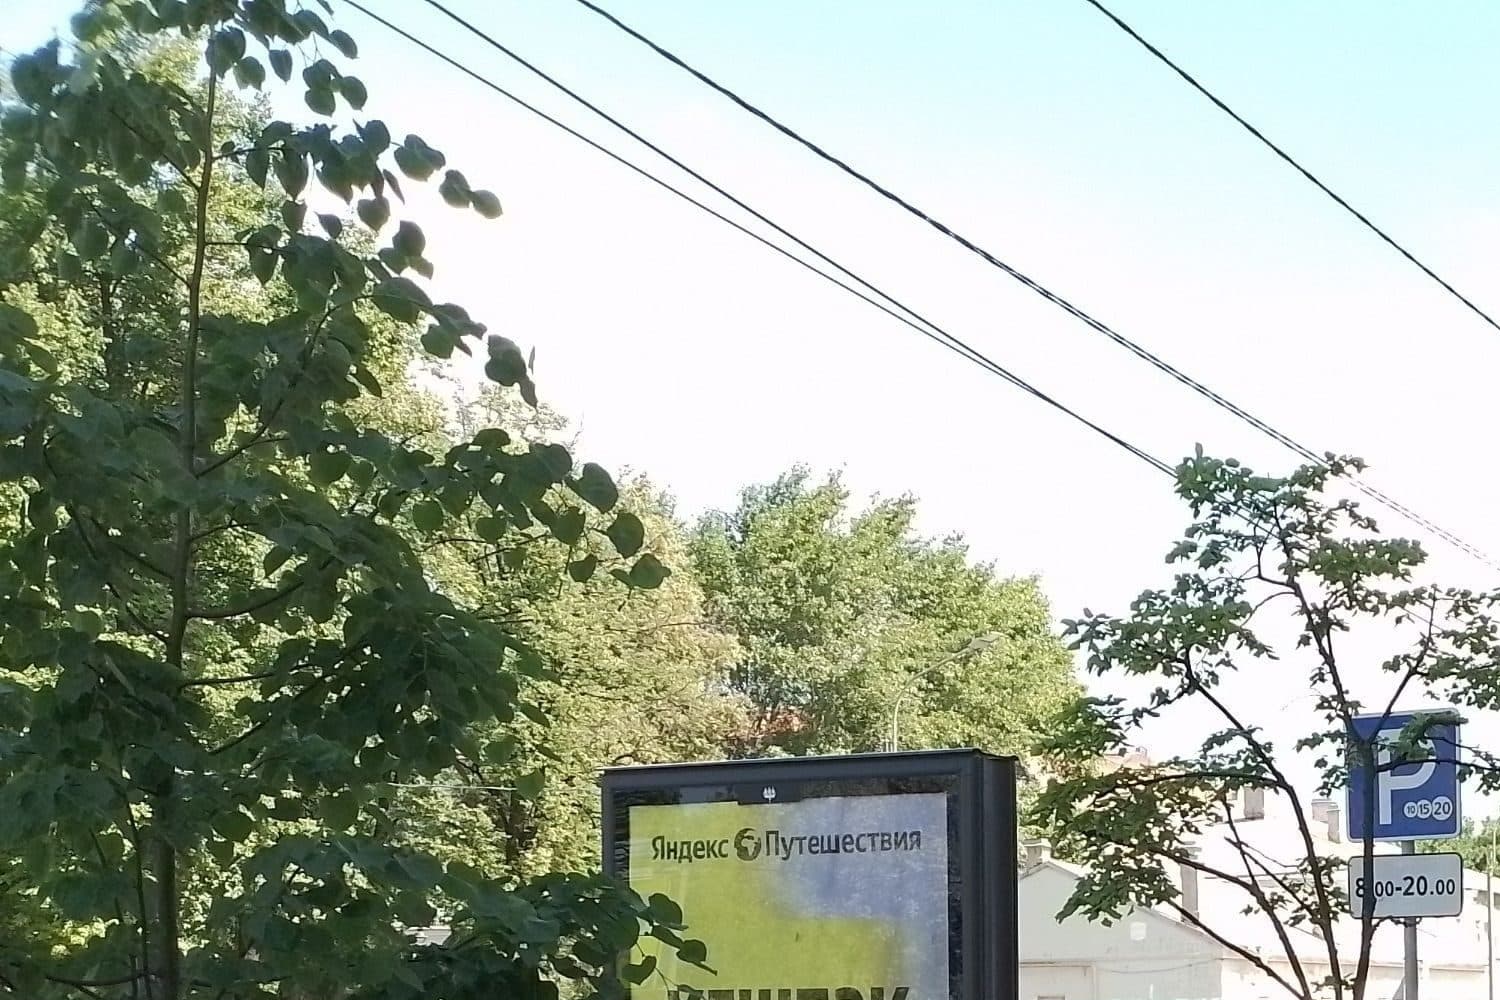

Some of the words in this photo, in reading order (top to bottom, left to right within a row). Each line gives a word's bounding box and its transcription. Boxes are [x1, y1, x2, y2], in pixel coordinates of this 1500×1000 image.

[652, 835, 729, 863] Яндекс
[765, 830, 921, 861] Путешествия
[1355, 875, 1456, 898] 800-20.00
